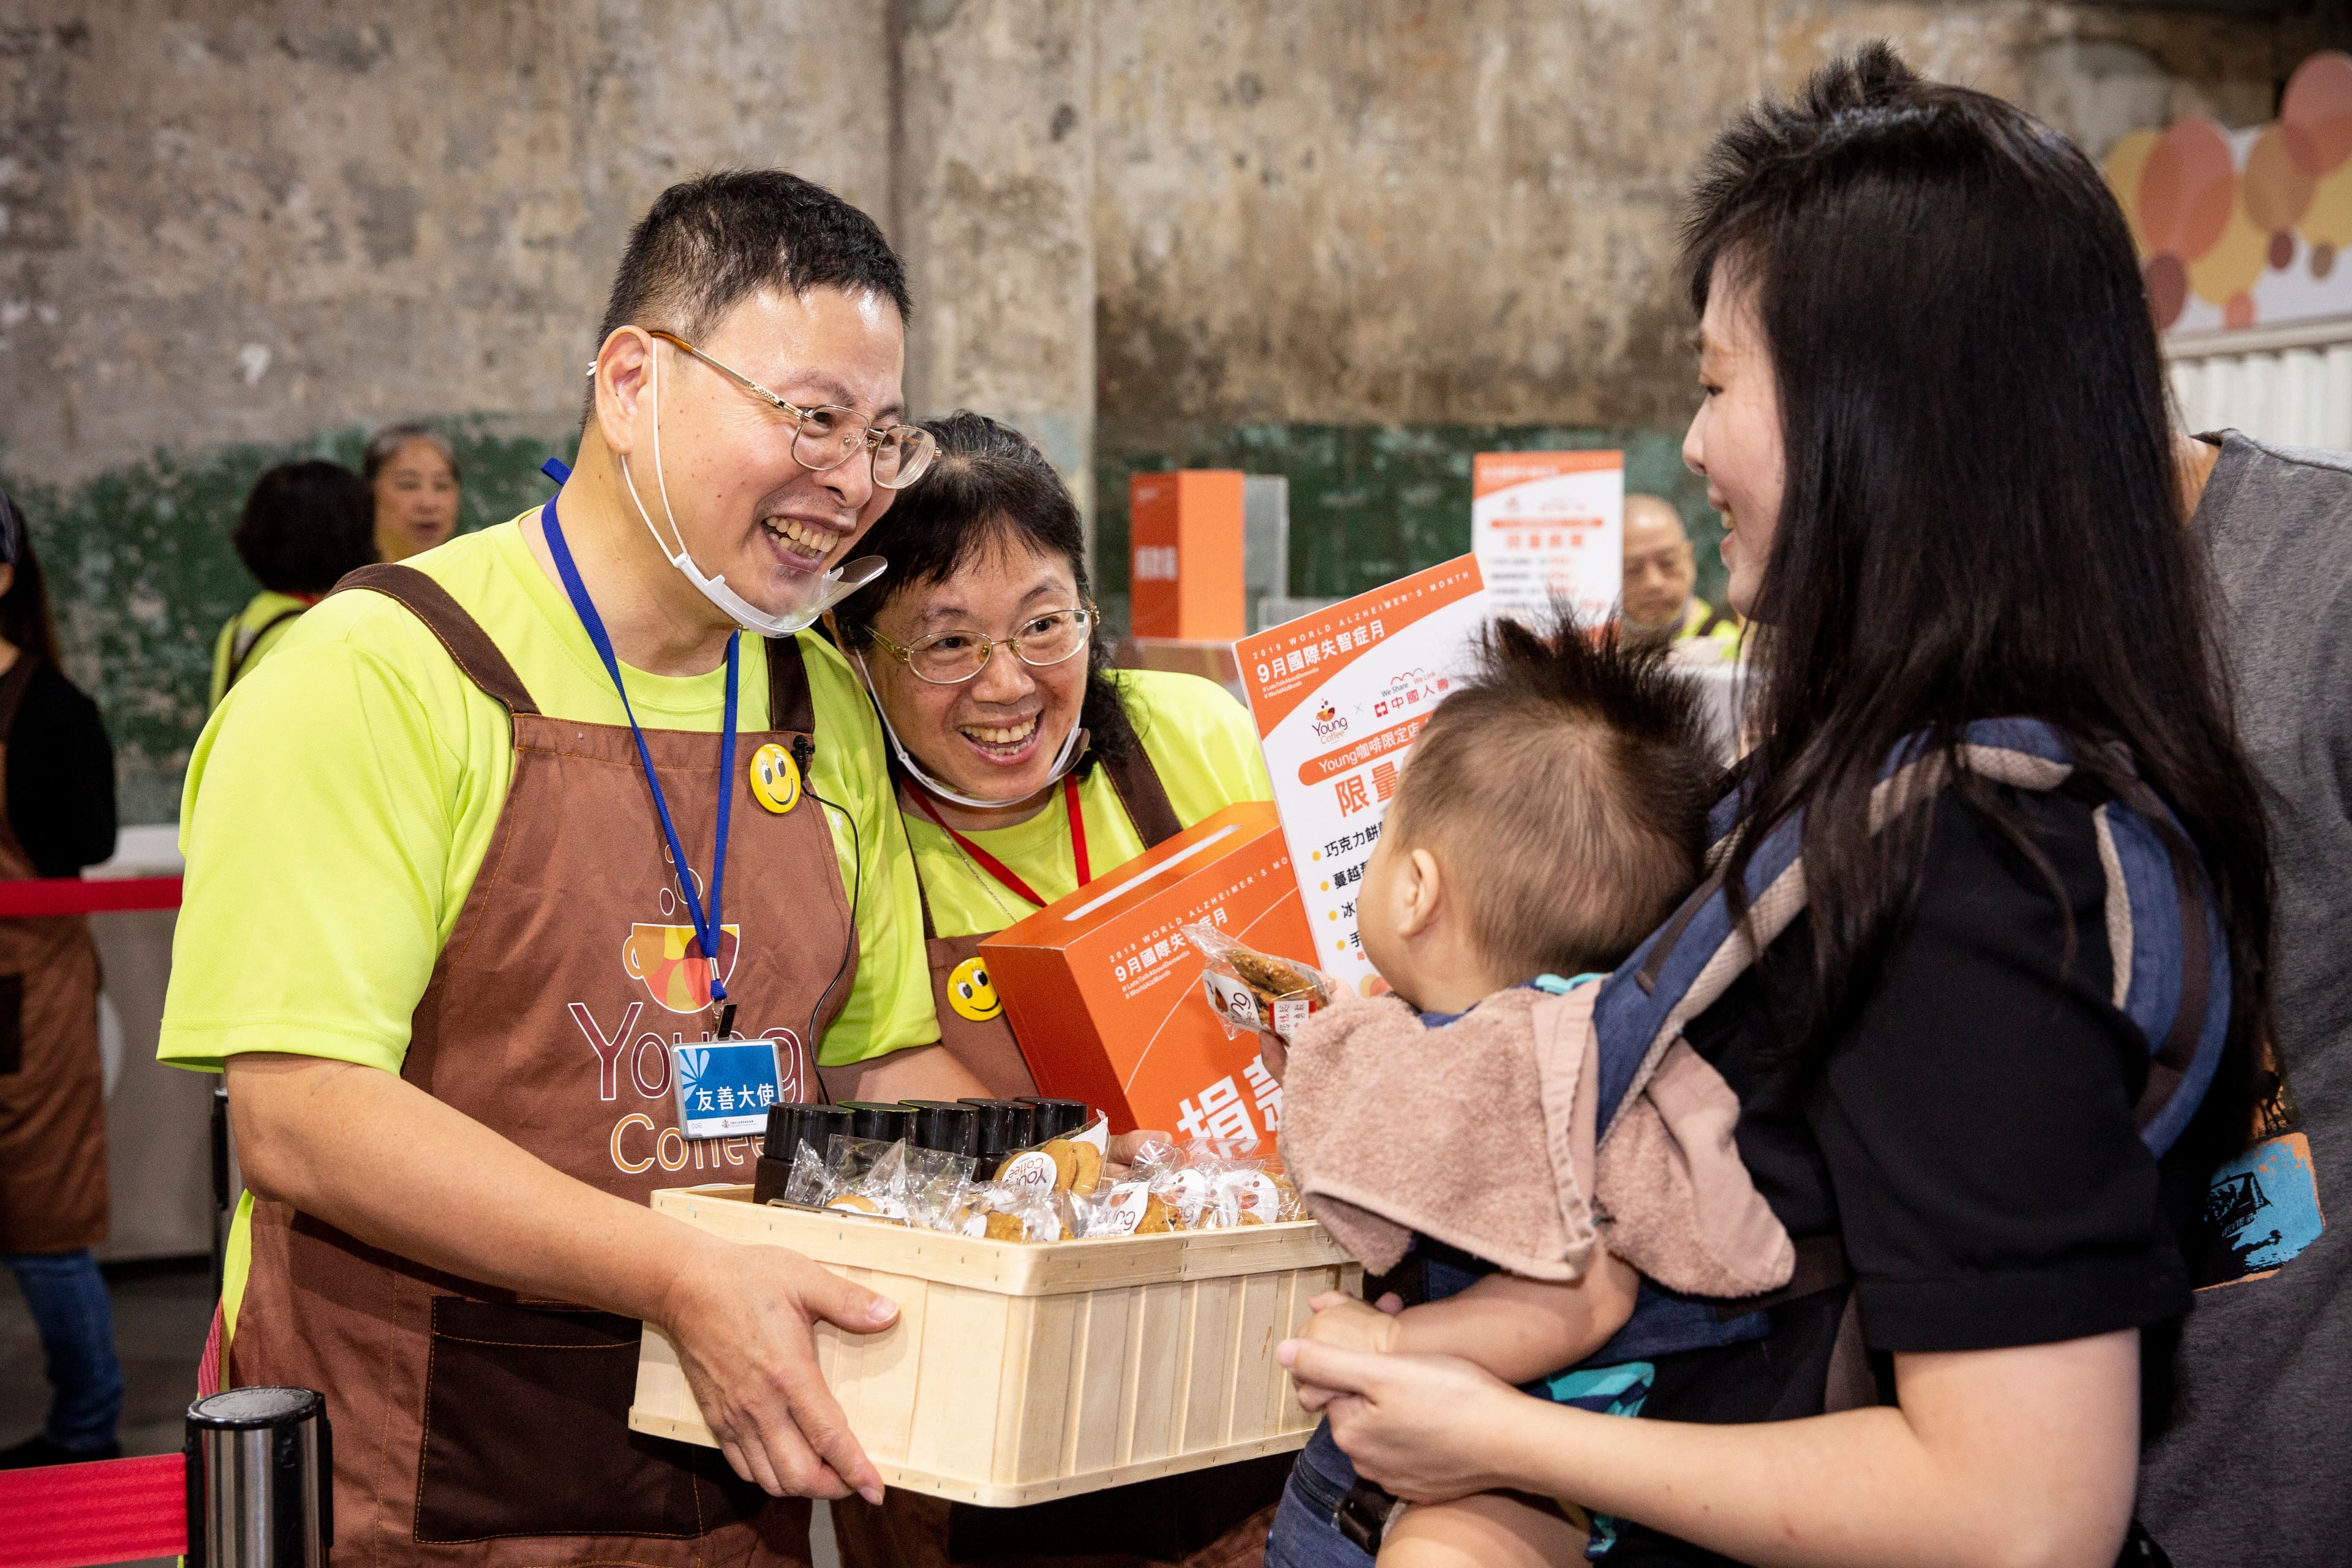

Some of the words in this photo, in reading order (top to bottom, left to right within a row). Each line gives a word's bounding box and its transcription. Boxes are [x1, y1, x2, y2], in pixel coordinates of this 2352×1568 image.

[1253, 643, 1281, 660] 2019
[1289, 625, 1331, 646] WORLD
[1339, 589, 1423, 627] ALZHEIMER'S
[1430, 571, 1469, 592] MONTH
[1257, 619, 1385, 683] 9月國際失智症月
[1381, 689, 1392, 698] We
[1392, 682, 1409, 694] Share
[1391, 677, 1449, 709] 中國人壽
[1312, 717, 1348, 737] Young
[1320, 730, 1345, 745] Coffee
[1109, 943, 1136, 963] 2019
[1142, 916, 1183, 944] WORLD
[1188, 869, 1268, 918] ALZHEIMER'S
[1114, 907, 1228, 982] 9月國際失月
[1122, 950, 1191, 992] #LetsTalkAboutDementia
[695, 1083, 775, 1112] 友善大使
[1008, 1157, 1044, 1178] Coffee
